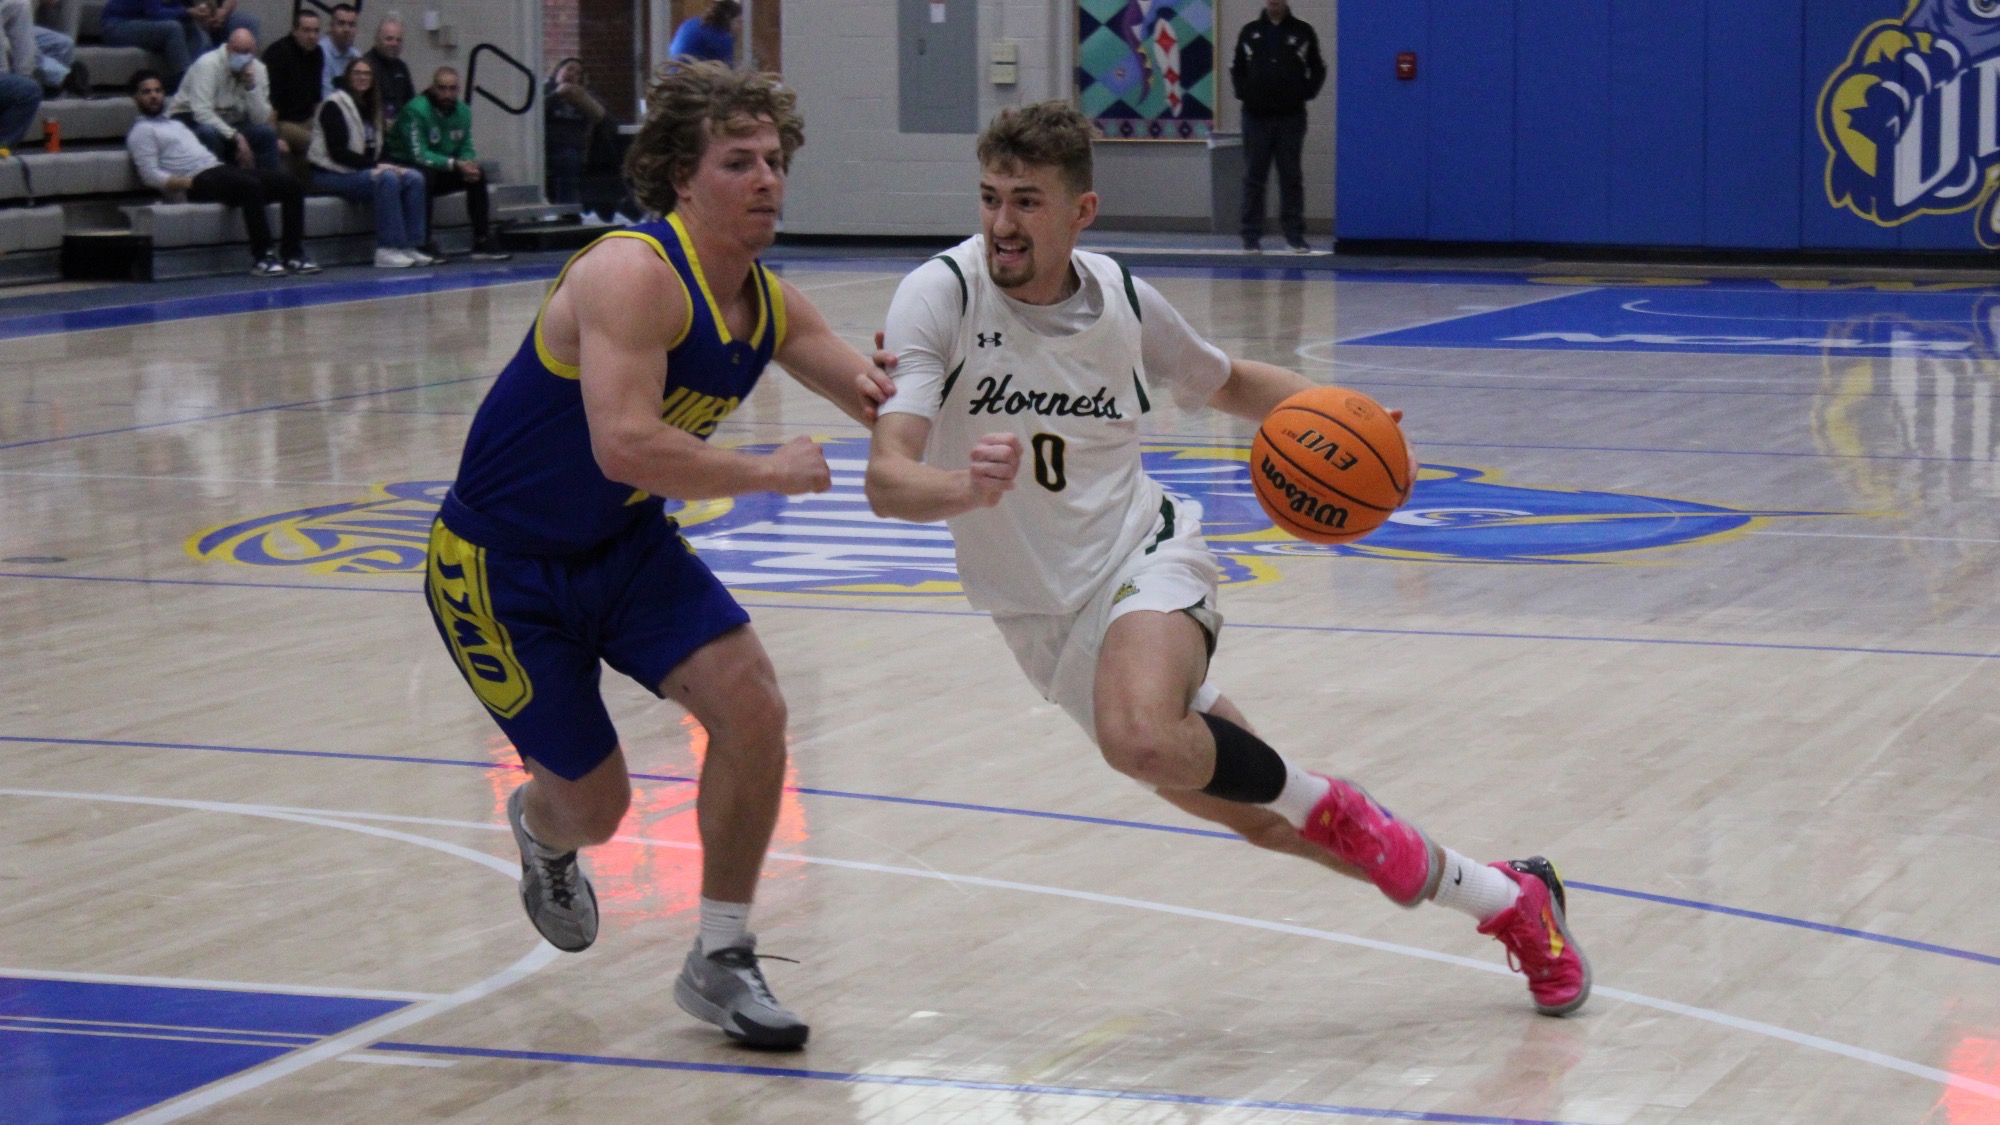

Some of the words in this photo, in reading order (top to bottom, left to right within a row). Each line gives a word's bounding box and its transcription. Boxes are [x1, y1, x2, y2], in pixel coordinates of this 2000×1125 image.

[968, 373, 1123, 419] Hornets
[1031, 432, 1067, 492] 0
[1296, 429, 1359, 471] EVO
[1260, 453, 1349, 529] Wilson
